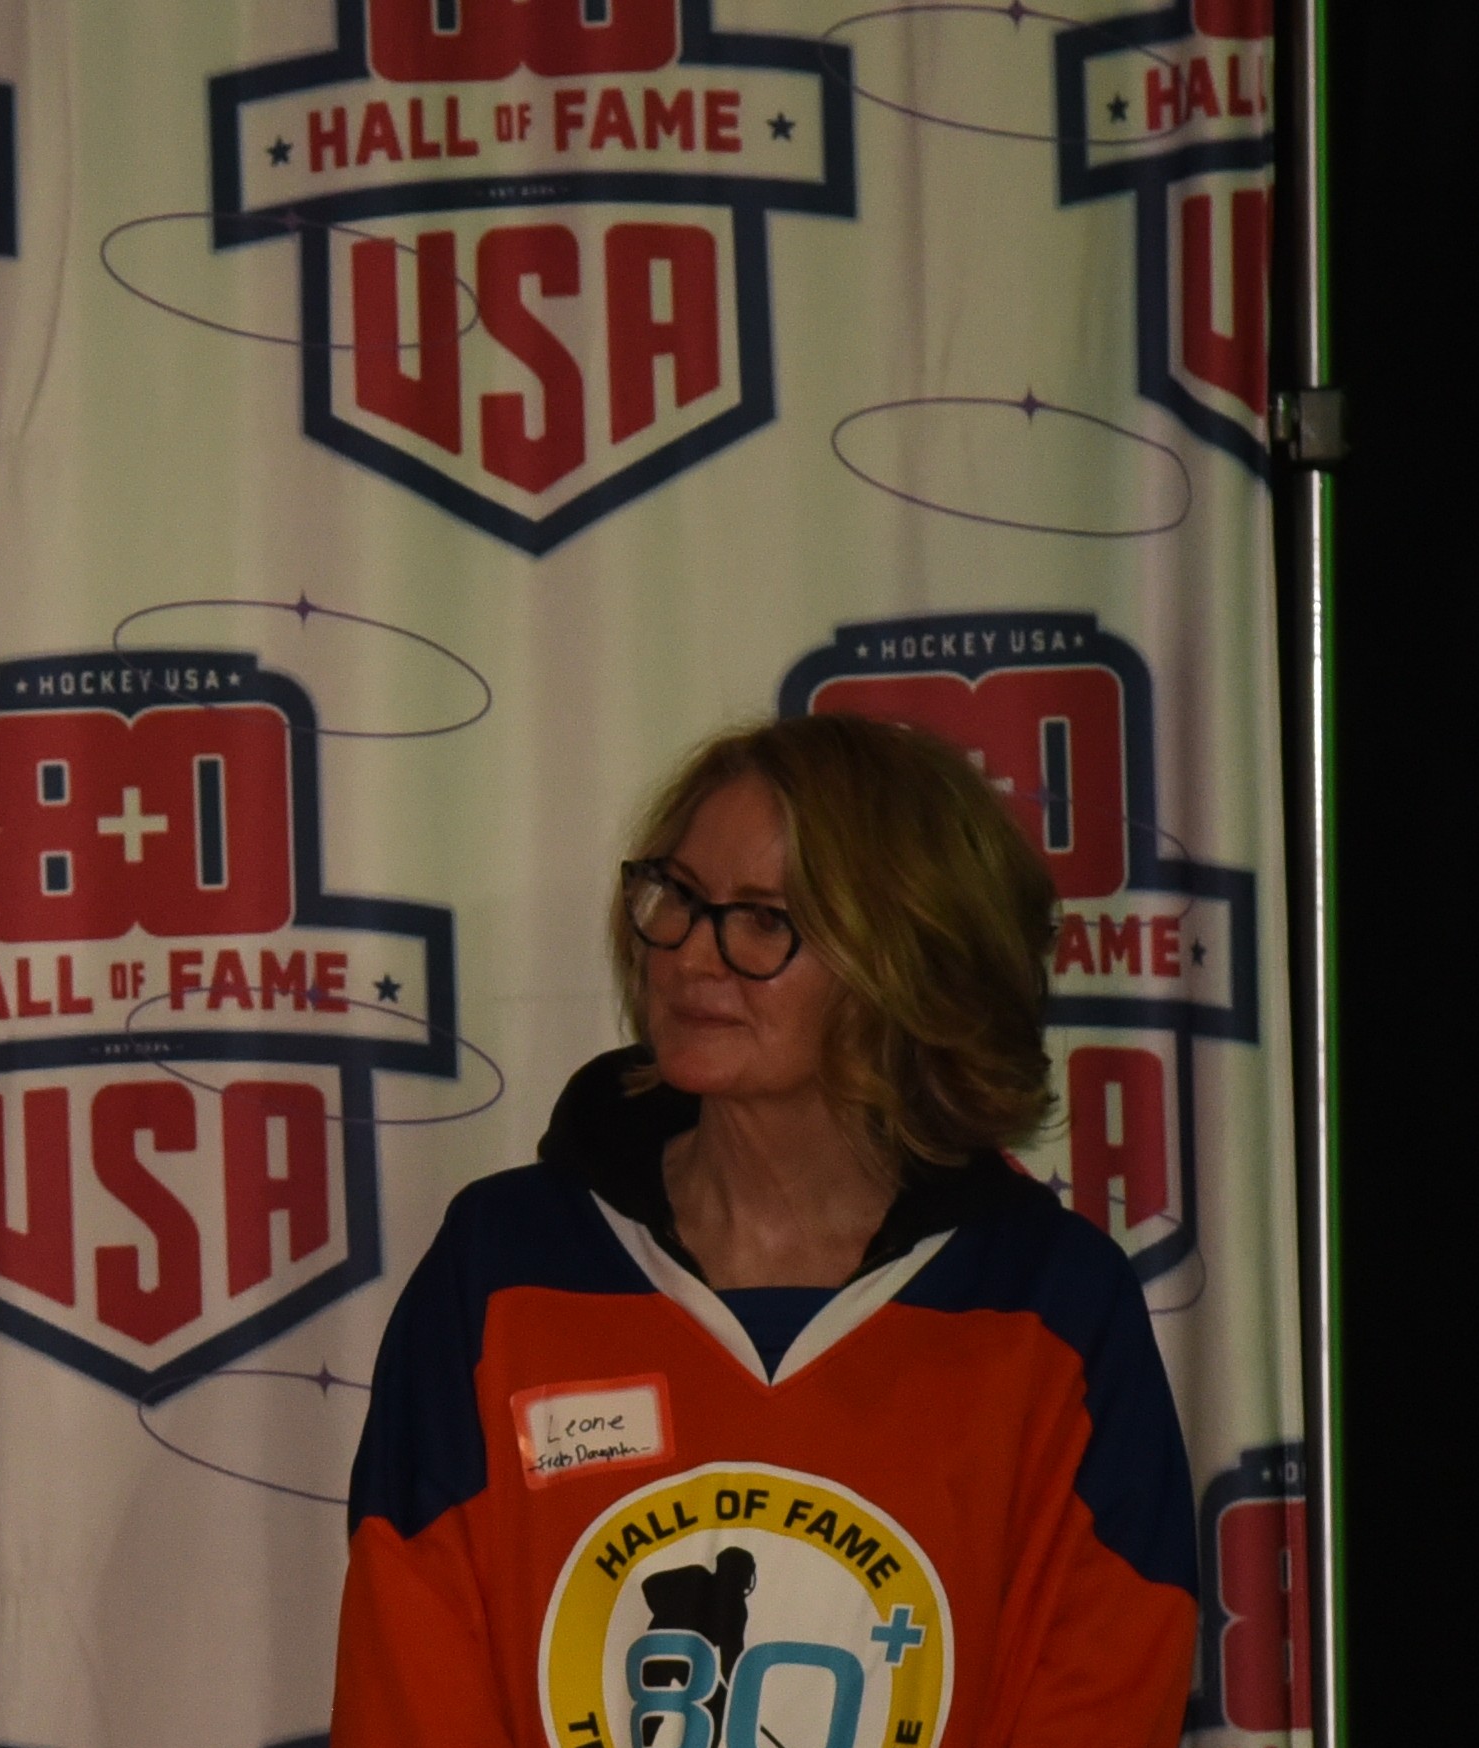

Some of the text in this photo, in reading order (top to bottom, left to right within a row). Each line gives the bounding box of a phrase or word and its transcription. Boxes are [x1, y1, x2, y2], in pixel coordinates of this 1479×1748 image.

[310, 89, 740, 172] HALL OF FAME
[352, 223, 719, 493] USA
[881, 629, 1065, 660] HOCKEY USA
[39, 667, 219, 695] HOCKEY USA
[1055, 915, 1180, 976] AME
[111, 963, 143, 999] OF
[170, 951, 348, 1012] FAME
[546, 1413, 625, 1444] Leone
[595, 1488, 902, 1590] HALL OF FAME
